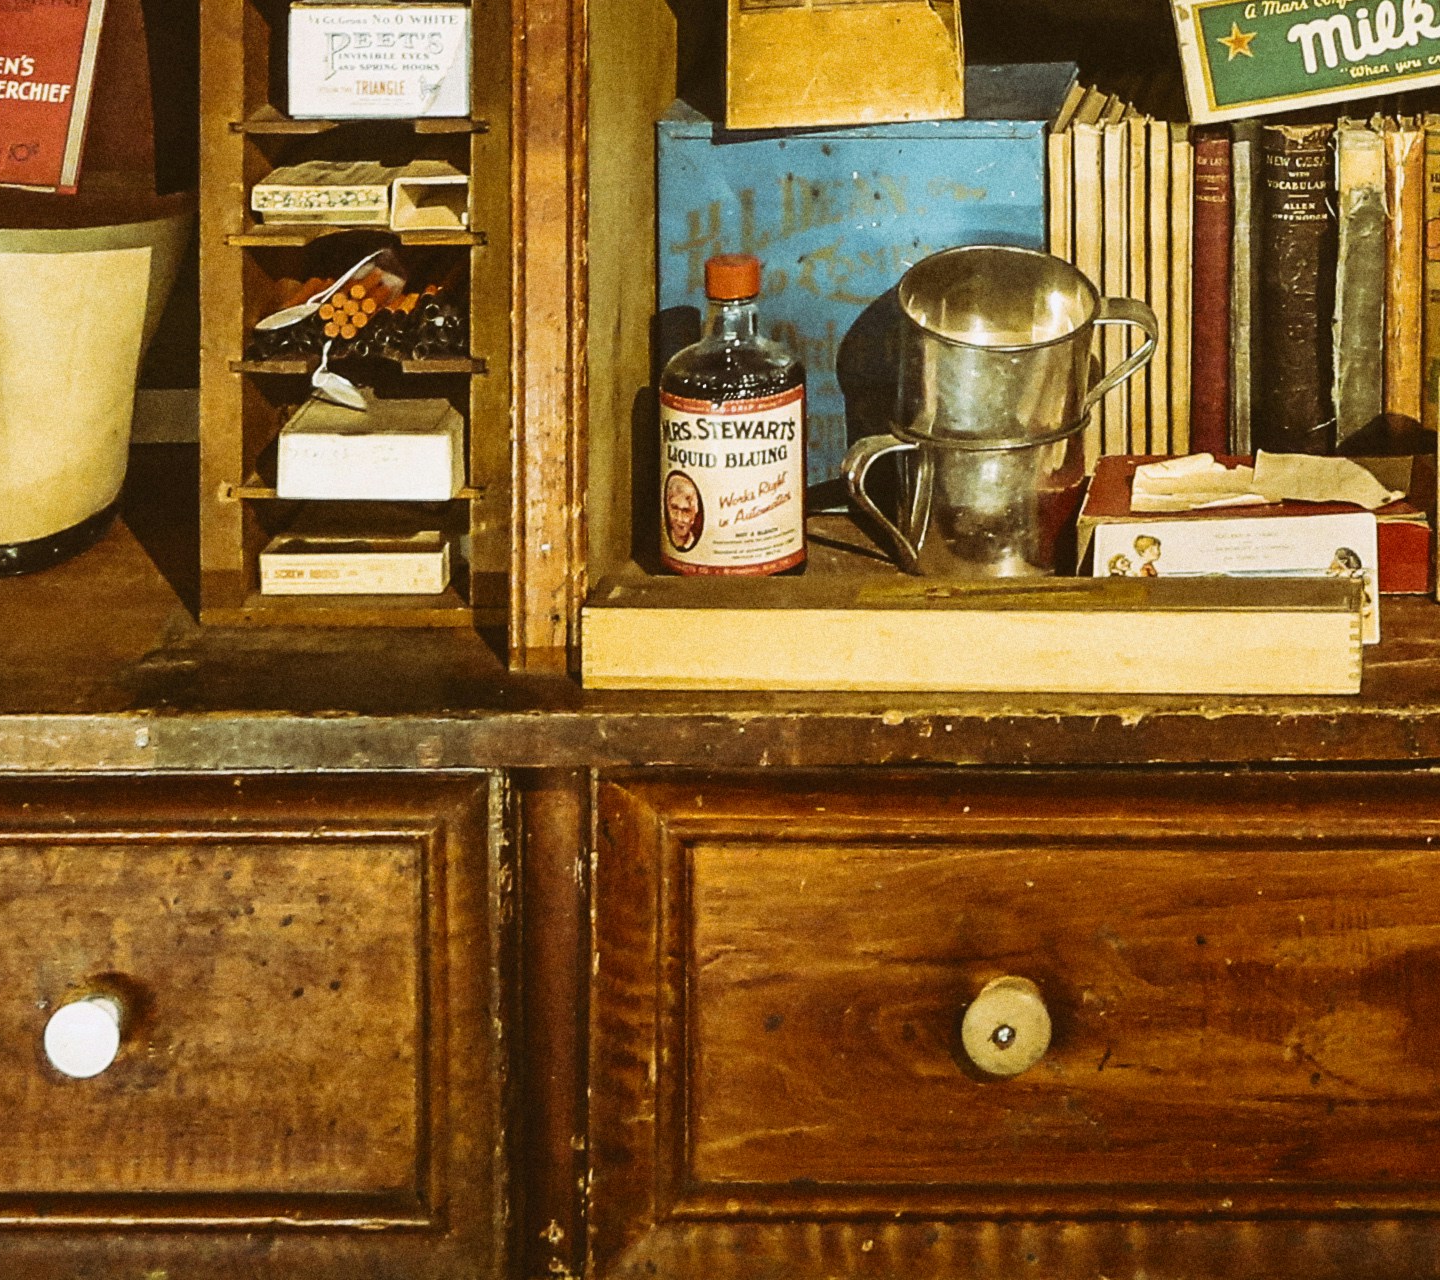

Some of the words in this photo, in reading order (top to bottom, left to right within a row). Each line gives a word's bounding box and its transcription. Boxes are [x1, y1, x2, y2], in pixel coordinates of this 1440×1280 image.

[1262, 0, 1309, 17] Mars
[324, 32, 444, 80] PEET'S
[1395, 56, 1423, 75] you
[356, 80, 406, 95] TRIANGLE
[696, 418, 795, 441] STEWART'S
[668, 445, 717, 468] LIQUID
[725, 445, 788, 468] BLUING
